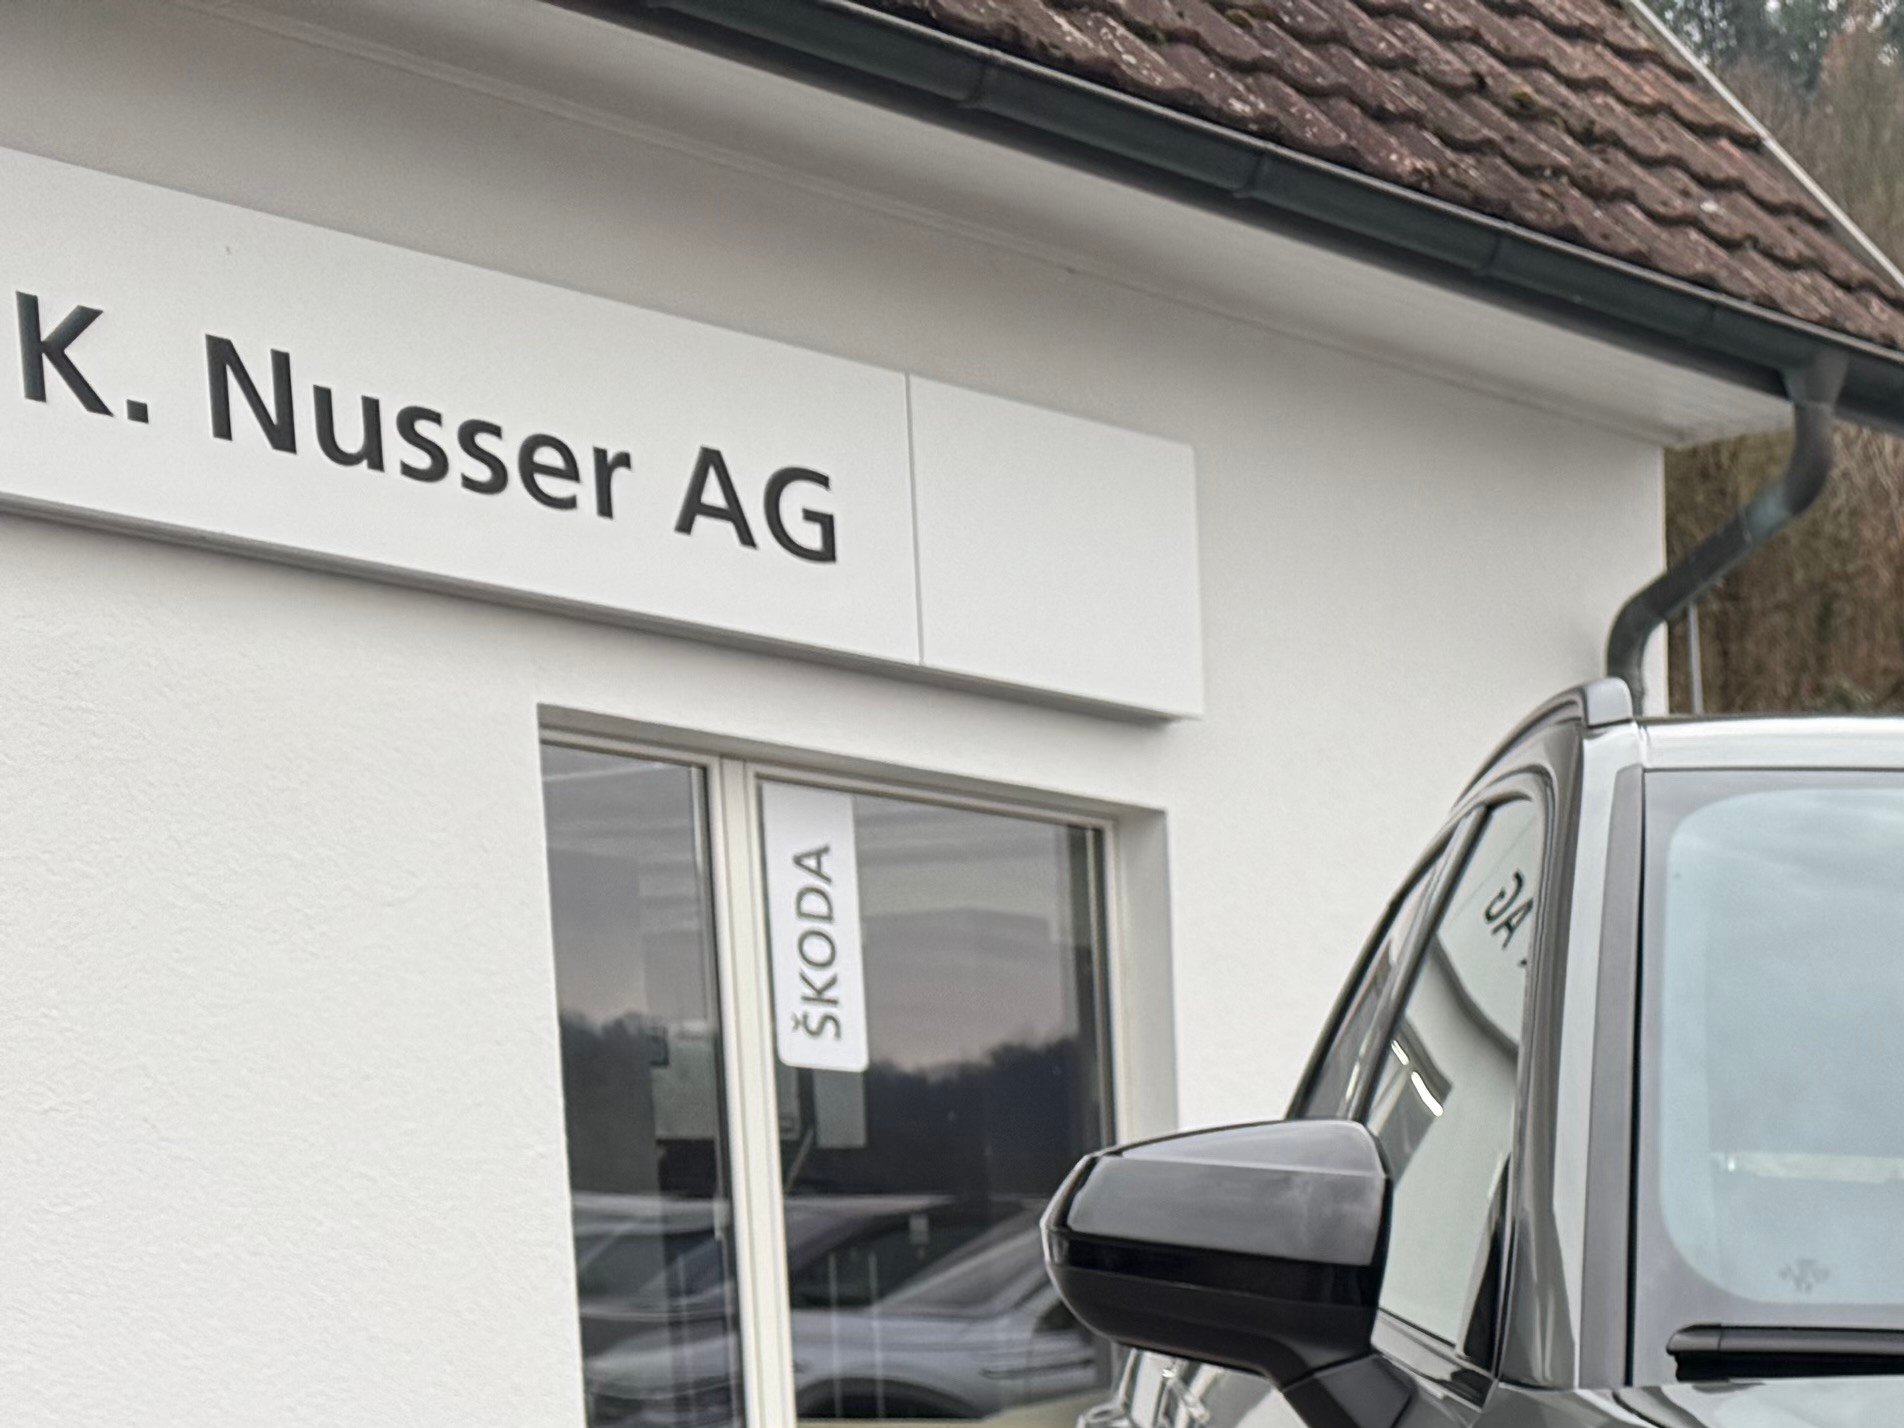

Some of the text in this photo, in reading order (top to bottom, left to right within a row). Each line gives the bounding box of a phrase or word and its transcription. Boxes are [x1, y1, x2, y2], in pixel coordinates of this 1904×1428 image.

[15, 290, 839, 564] K. Nusser AG
[791, 843, 842, 1041] ŠKODA
